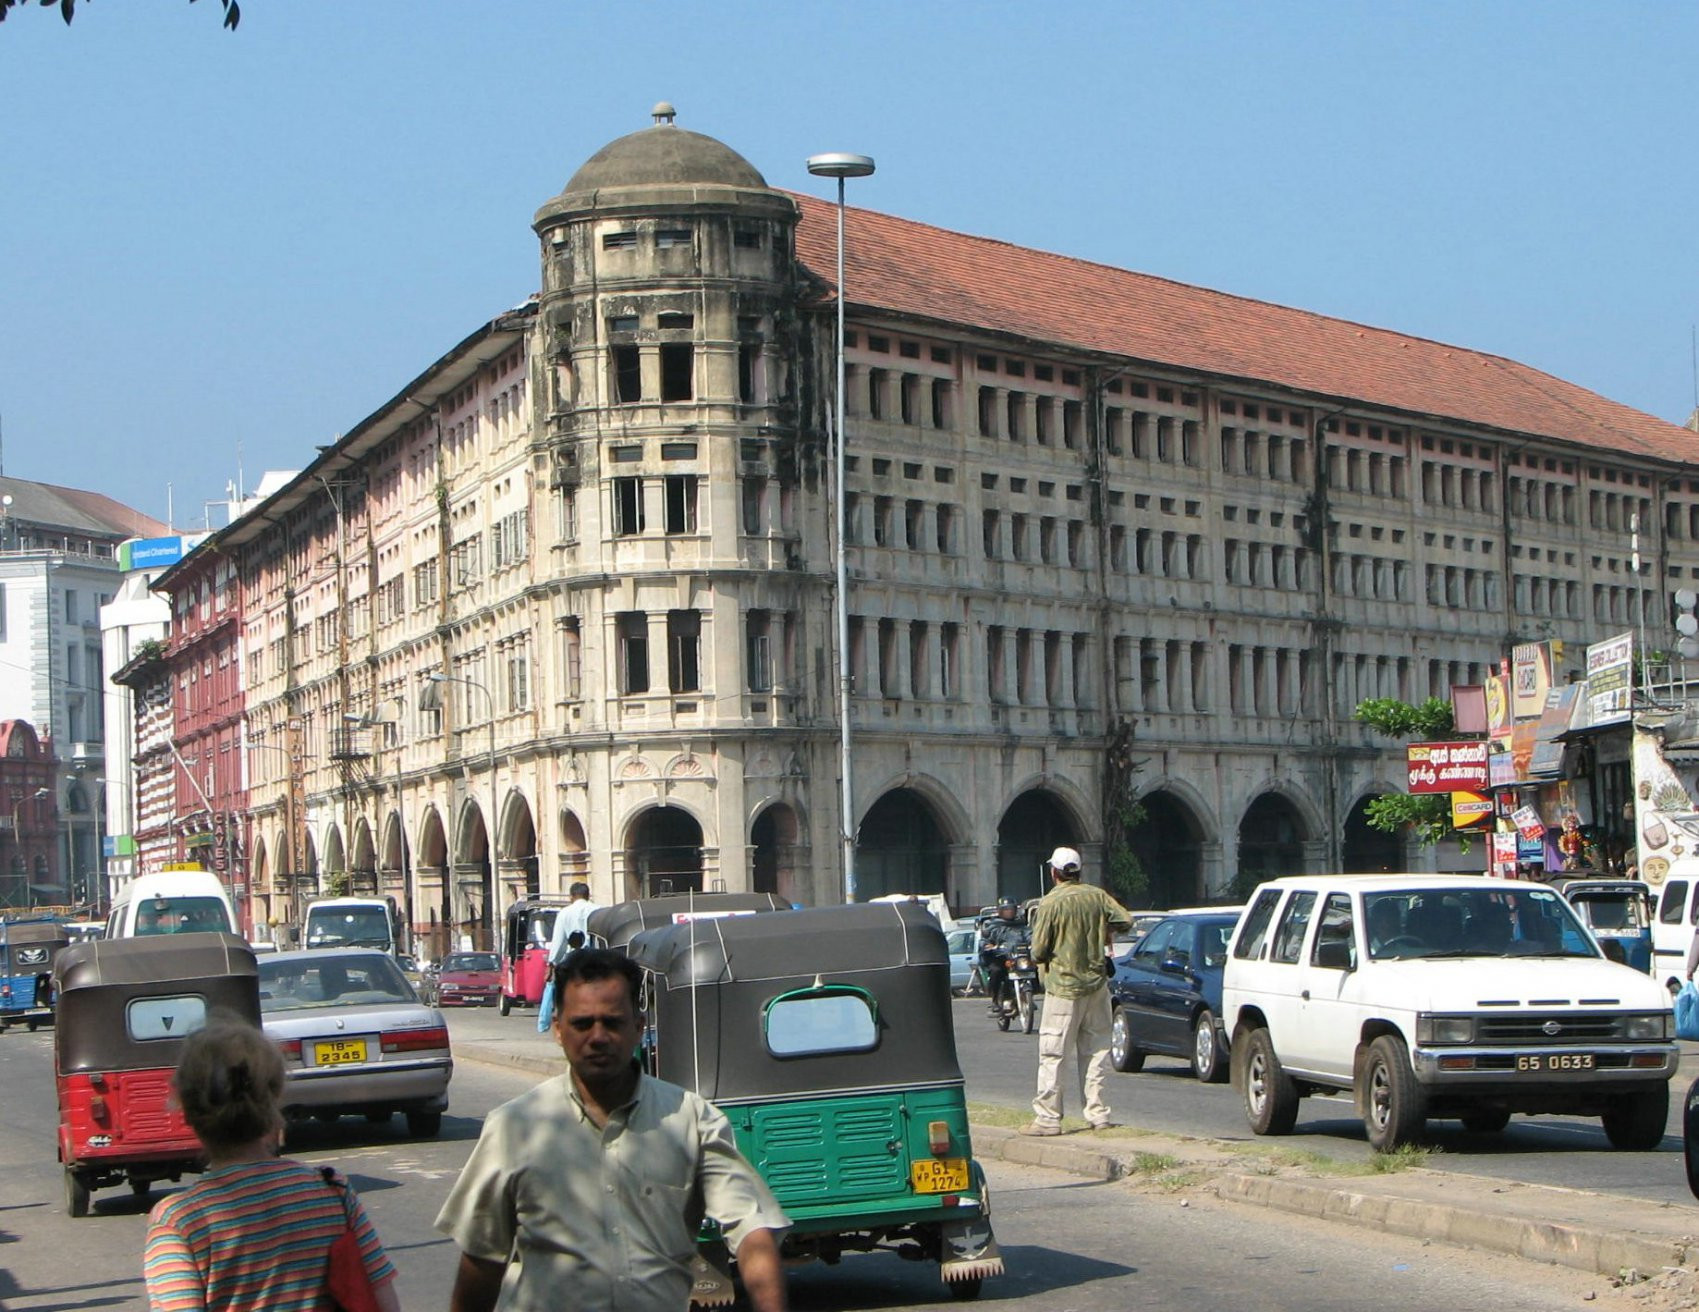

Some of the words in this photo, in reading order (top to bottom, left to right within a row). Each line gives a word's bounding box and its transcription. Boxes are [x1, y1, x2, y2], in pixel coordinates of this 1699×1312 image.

[214, 813, 225, 870] CAVES
[321, 1051, 361, 1062] 2345
[1518, 1057, 1540, 1070] 65
[1548, 1055, 1592, 1069] 0633
